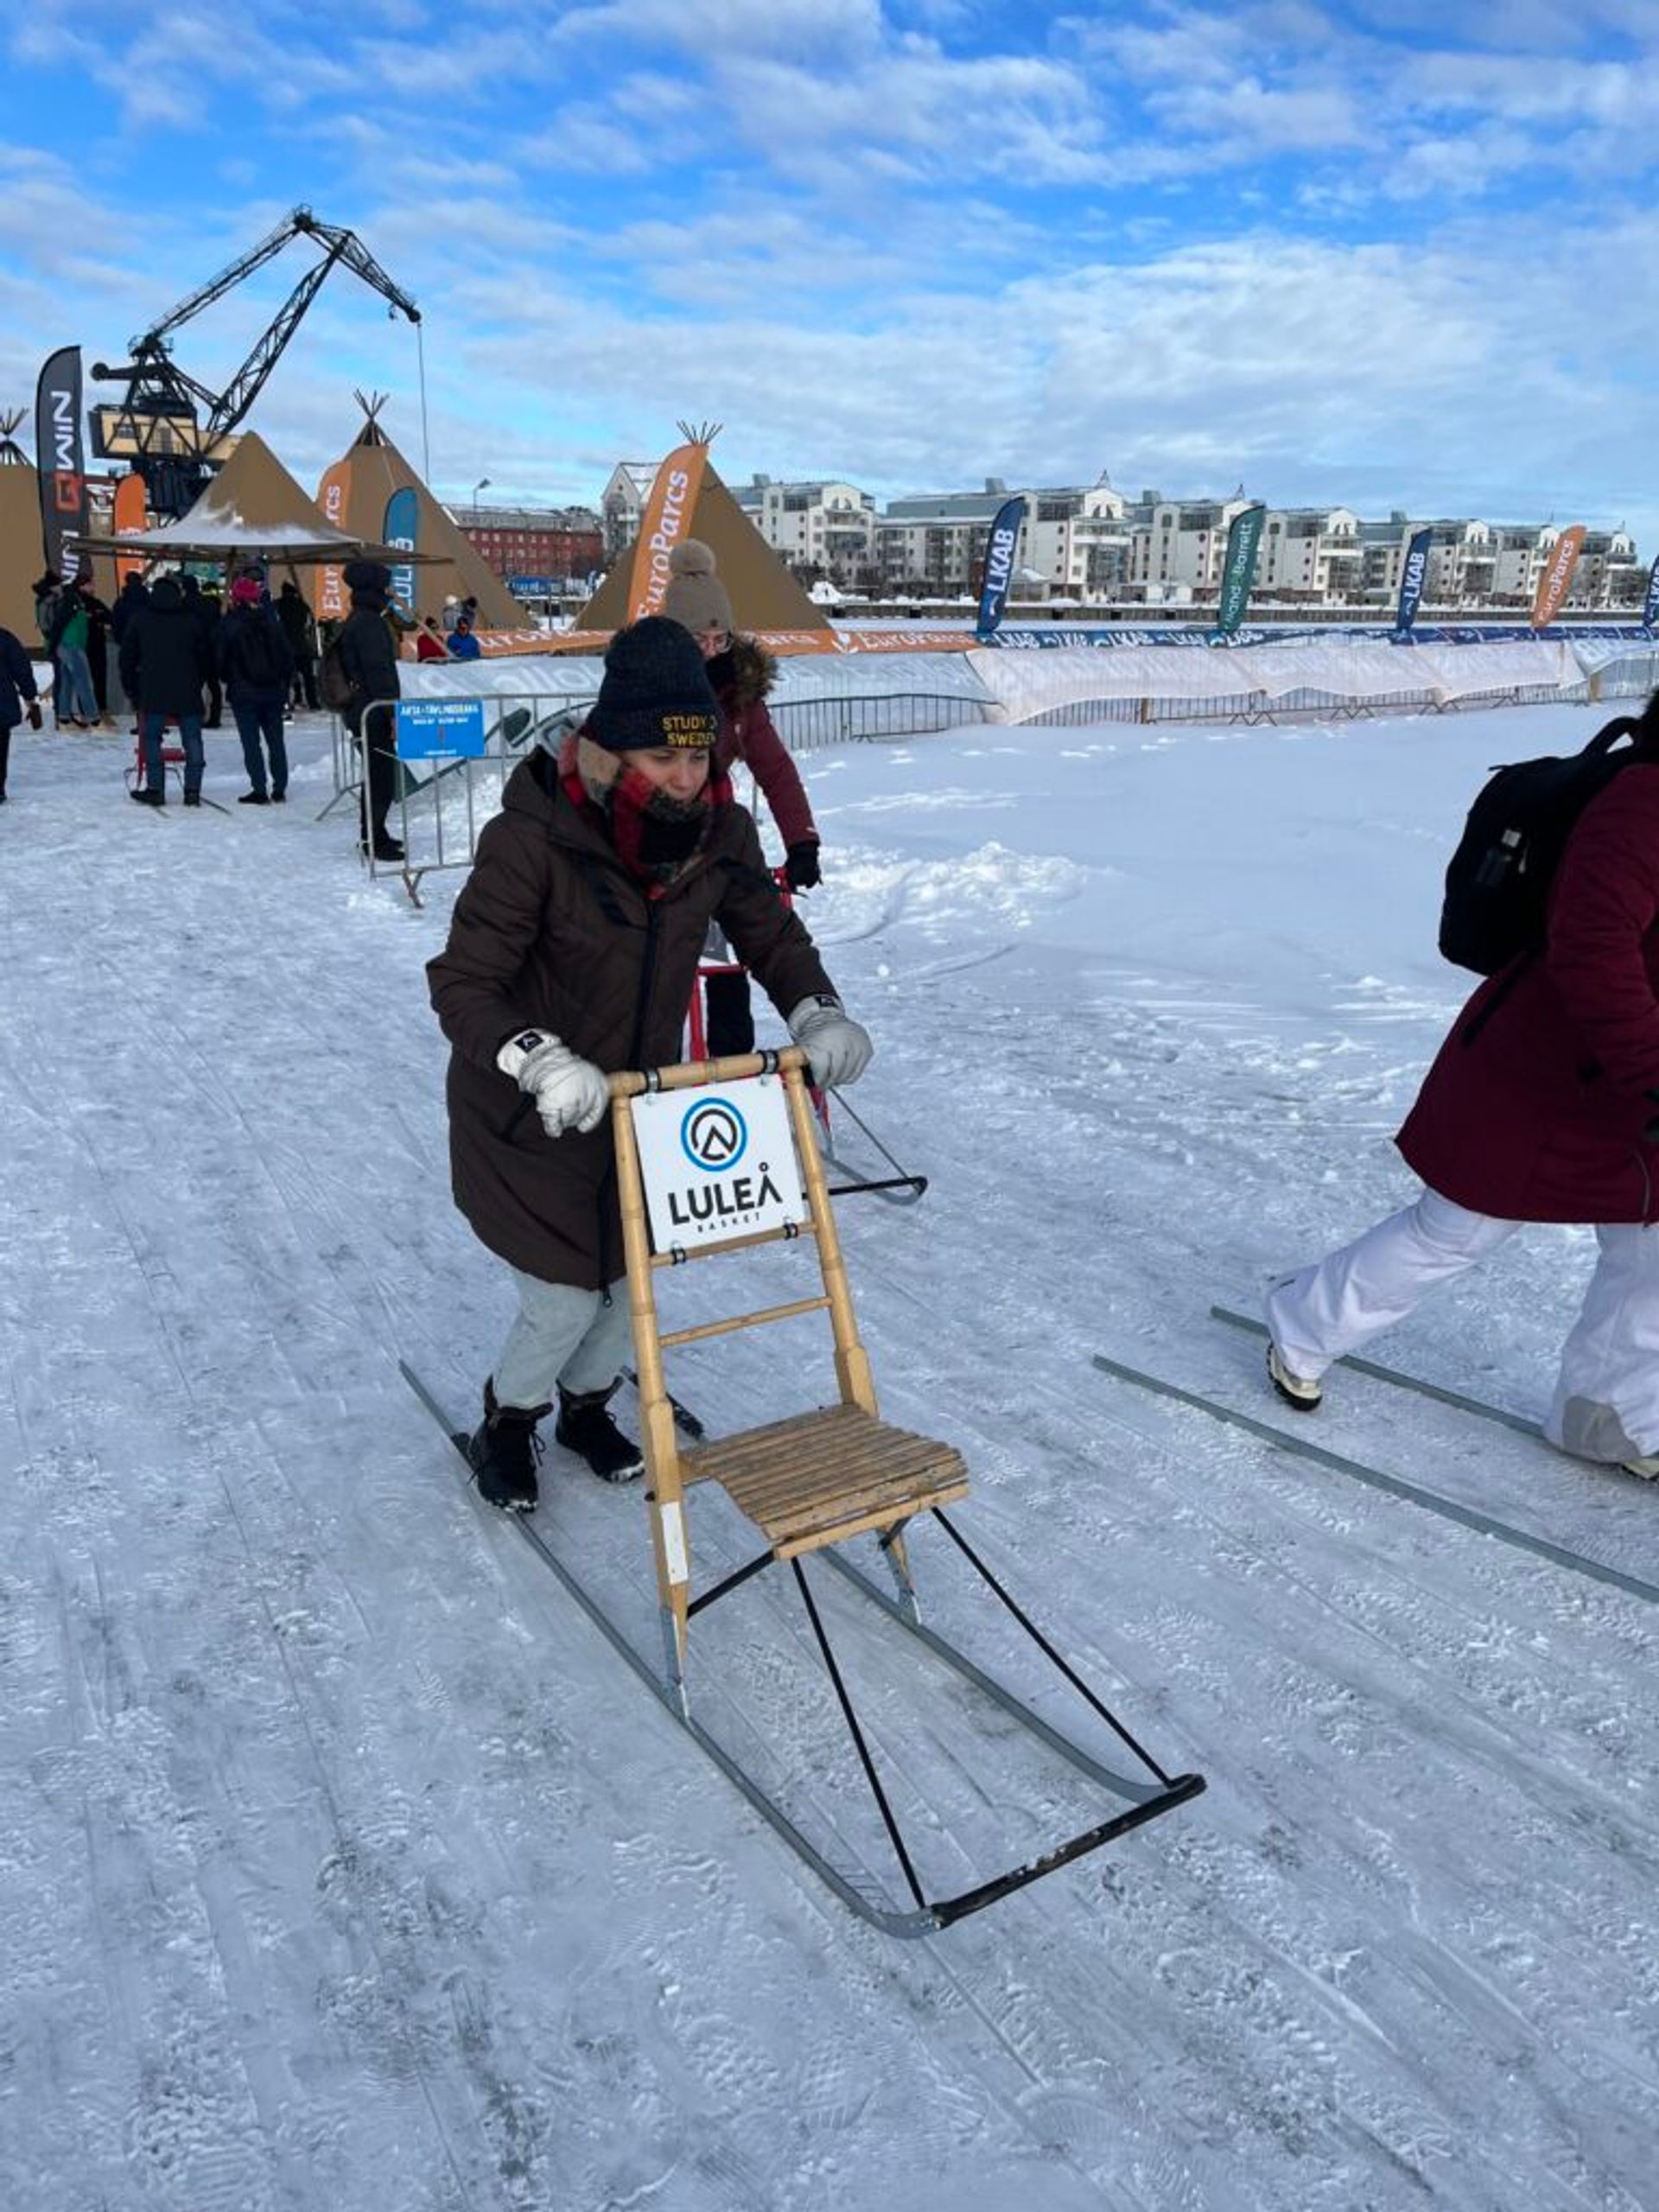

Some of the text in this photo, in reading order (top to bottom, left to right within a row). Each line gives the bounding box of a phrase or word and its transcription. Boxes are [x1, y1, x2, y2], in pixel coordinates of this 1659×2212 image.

[988, 529, 1014, 593] LKAB
[1404, 553, 1425, 598] LKAB
[663, 715, 707, 731] STUDY
[668, 1162, 783, 1226] LULEÅ
[697, 1212, 760, 1233] BASKET
